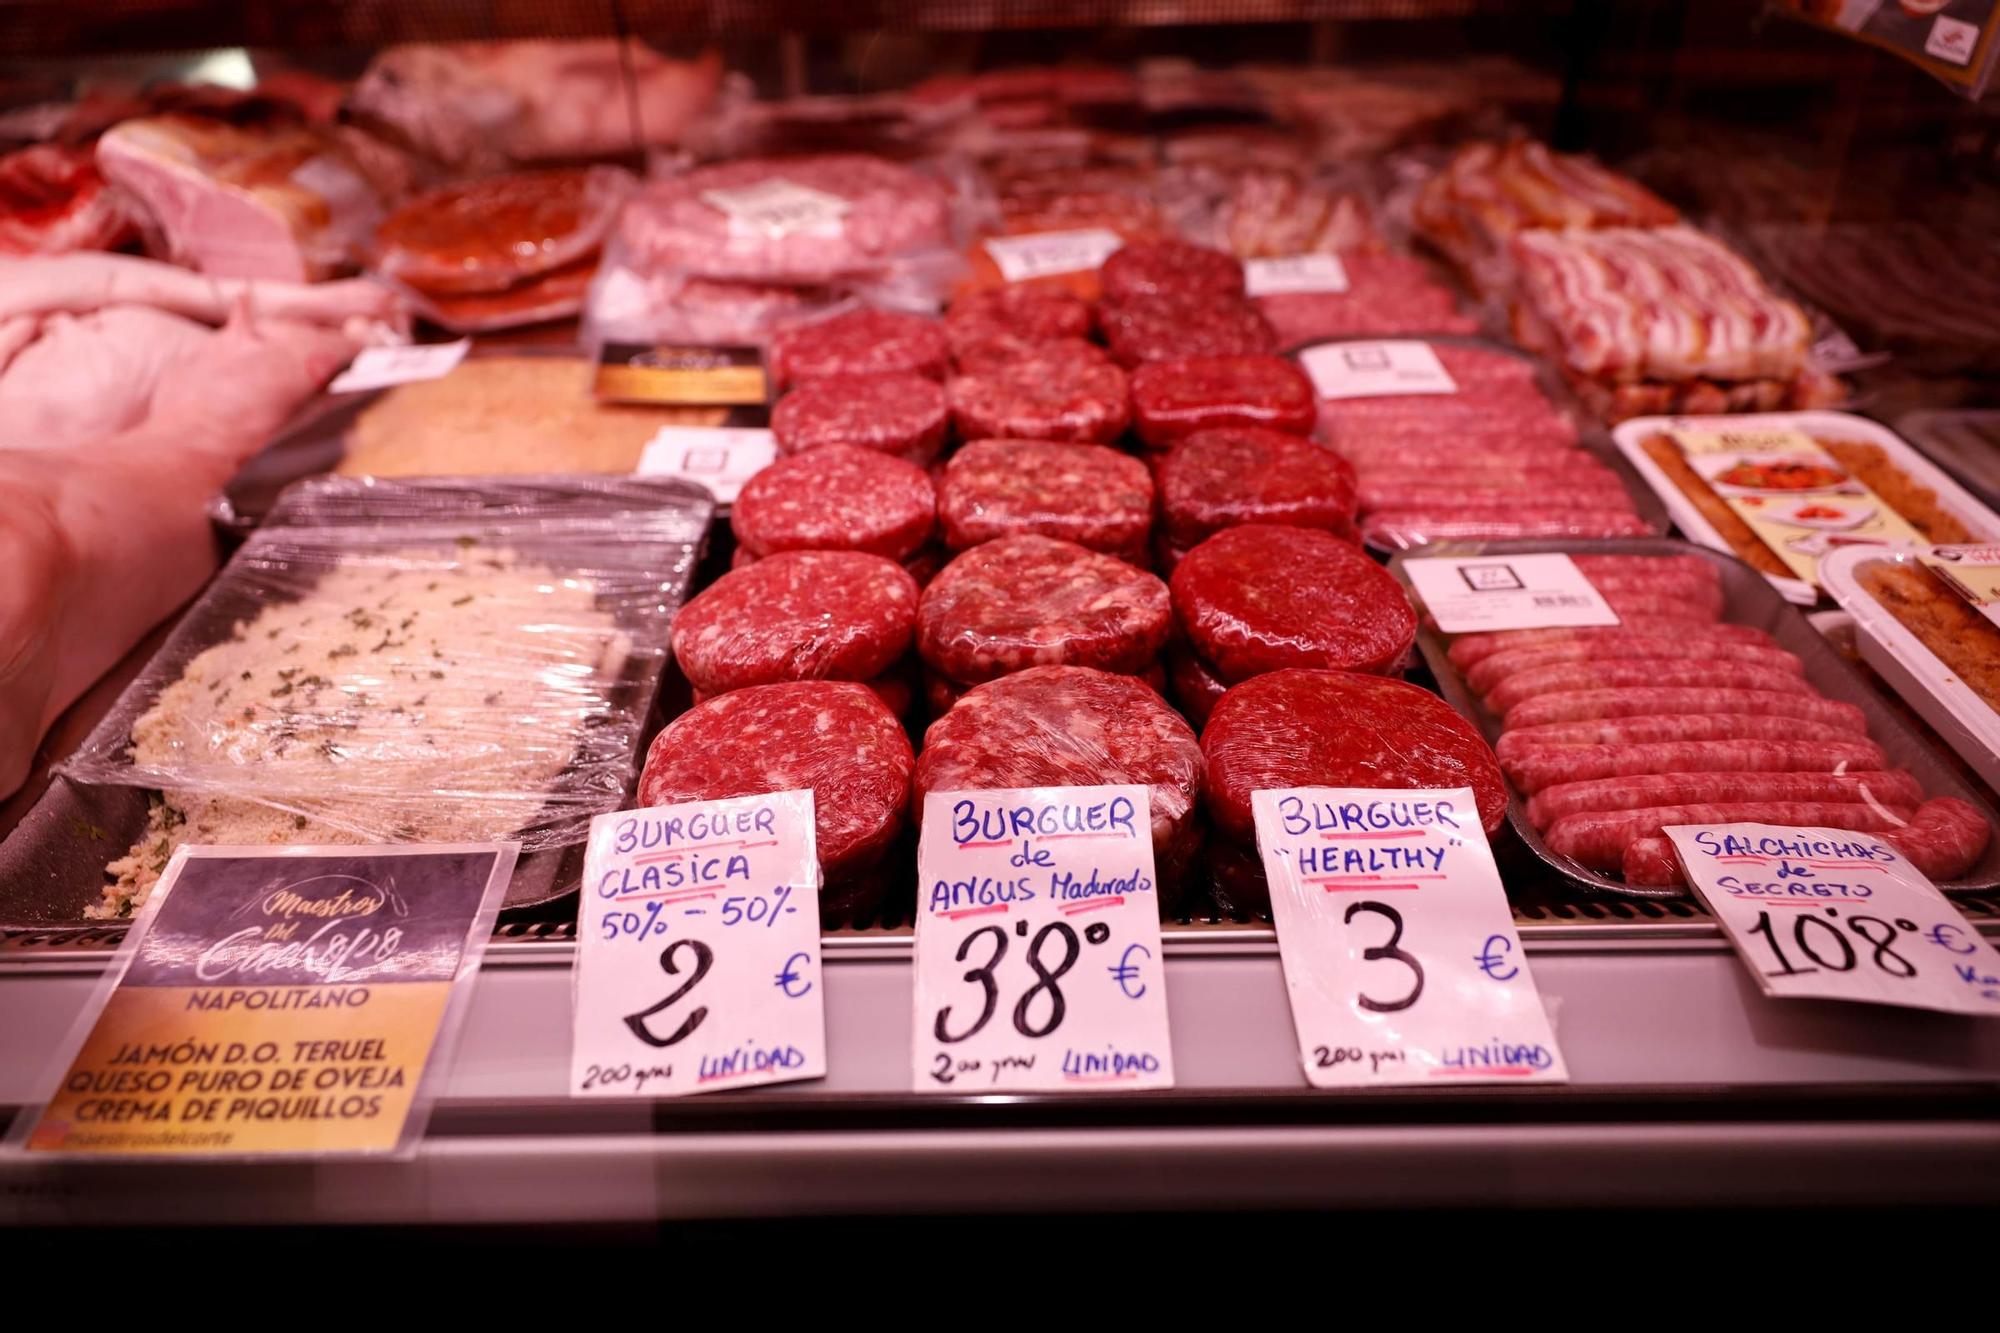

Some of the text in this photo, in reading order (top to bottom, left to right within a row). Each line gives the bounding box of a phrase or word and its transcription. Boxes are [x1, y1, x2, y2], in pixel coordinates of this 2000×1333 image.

[615, 807, 776, 854] BURGUER
[953, 797, 1136, 843] BURGUER
[1279, 796, 1460, 835] BURGUER
[1011, 840, 1055, 867] de
[1777, 860, 1815, 879] de
[930, 868, 1151, 912] ANGUS Madurado
[1716, 876, 1873, 898] SECRETO
[265, 889, 379, 918] Maestros
[601, 901, 668, 941] 50%
[1923, 923, 1977, 955] €
[1108, 943, 1151, 999] €
[1345, 901, 1518, 1013] 3 €
[186, 988, 370, 1010] NAPOLITANO
[623, 939, 812, 1047] 2 €
[109, 1037, 387, 1065] JAMÓN D.O. TERUEL
[1314, 1046, 1362, 1068] 200
[67, 1066, 405, 1094] QUESO PURO DE OVEJA
[582, 1064, 631, 1090] 200
[930, 1052, 981, 1083] 200
[75, 1095, 384, 1123] CREMA DE PIQUILLOS
